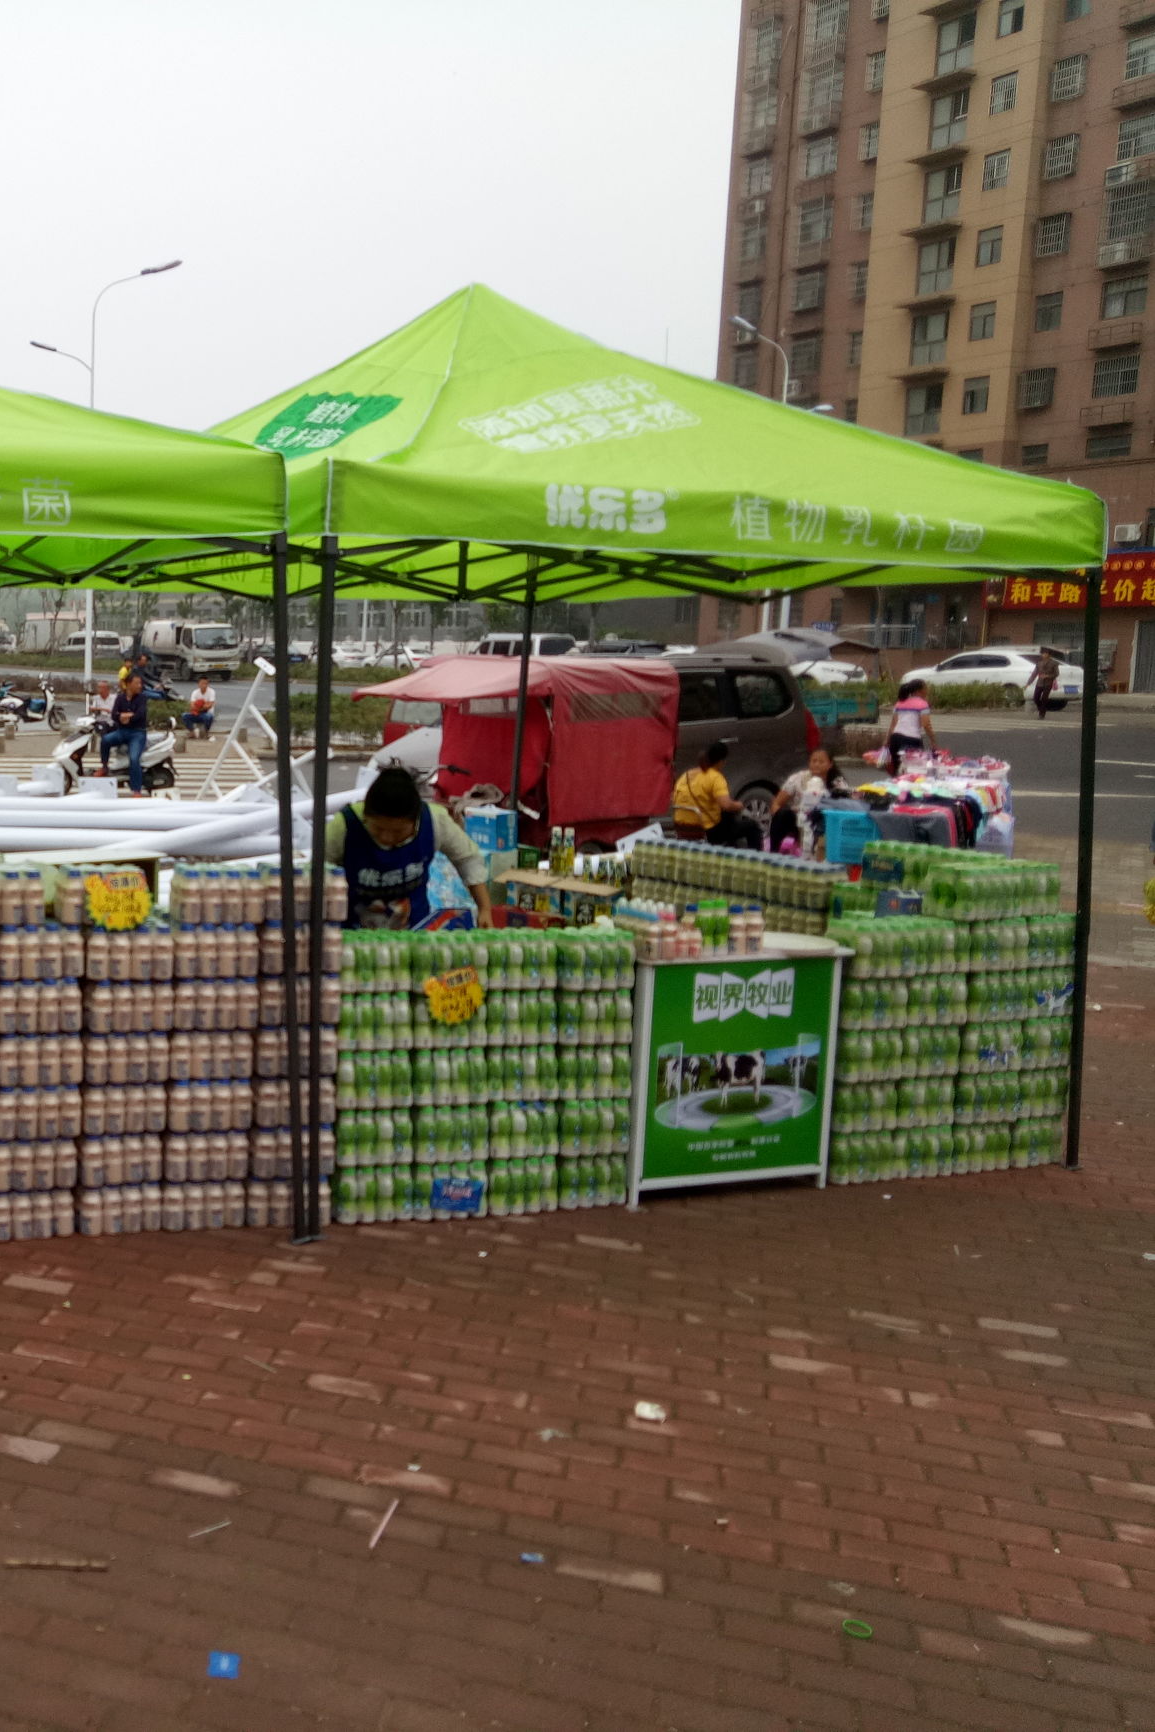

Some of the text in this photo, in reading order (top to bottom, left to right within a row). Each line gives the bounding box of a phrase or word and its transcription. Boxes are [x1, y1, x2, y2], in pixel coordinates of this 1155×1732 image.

[545, 482, 985, 553] 优乐多 植物乳杆菌
[696, 981, 792, 1012] 视界牧业
